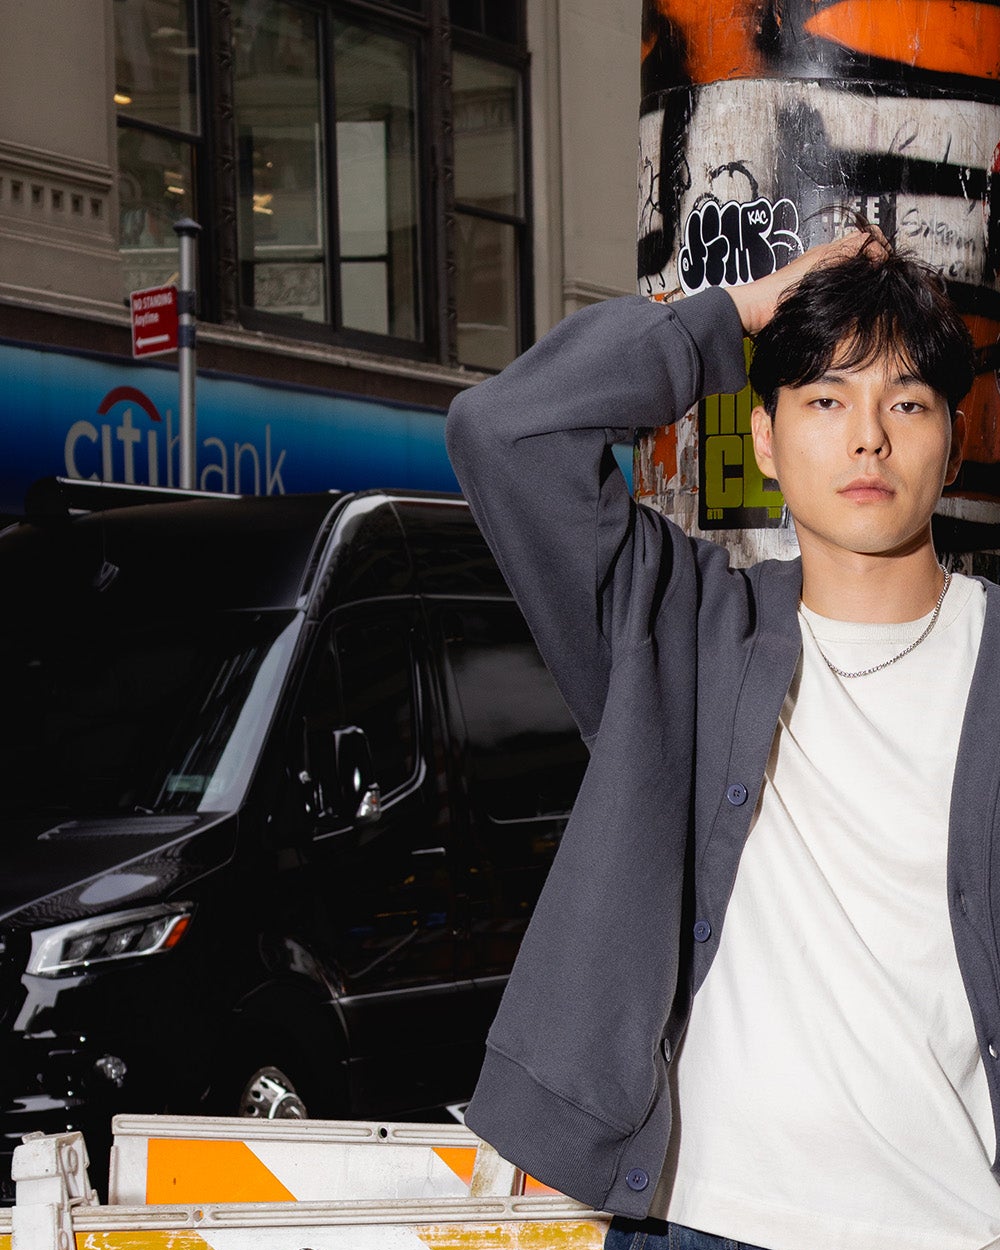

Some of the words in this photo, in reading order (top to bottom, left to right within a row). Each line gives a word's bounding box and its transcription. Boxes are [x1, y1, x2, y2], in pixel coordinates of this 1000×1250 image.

[747, 209, 769, 226] KAC
[133, 298, 143, 311] NO
[142, 292, 173, 309] STANDING
